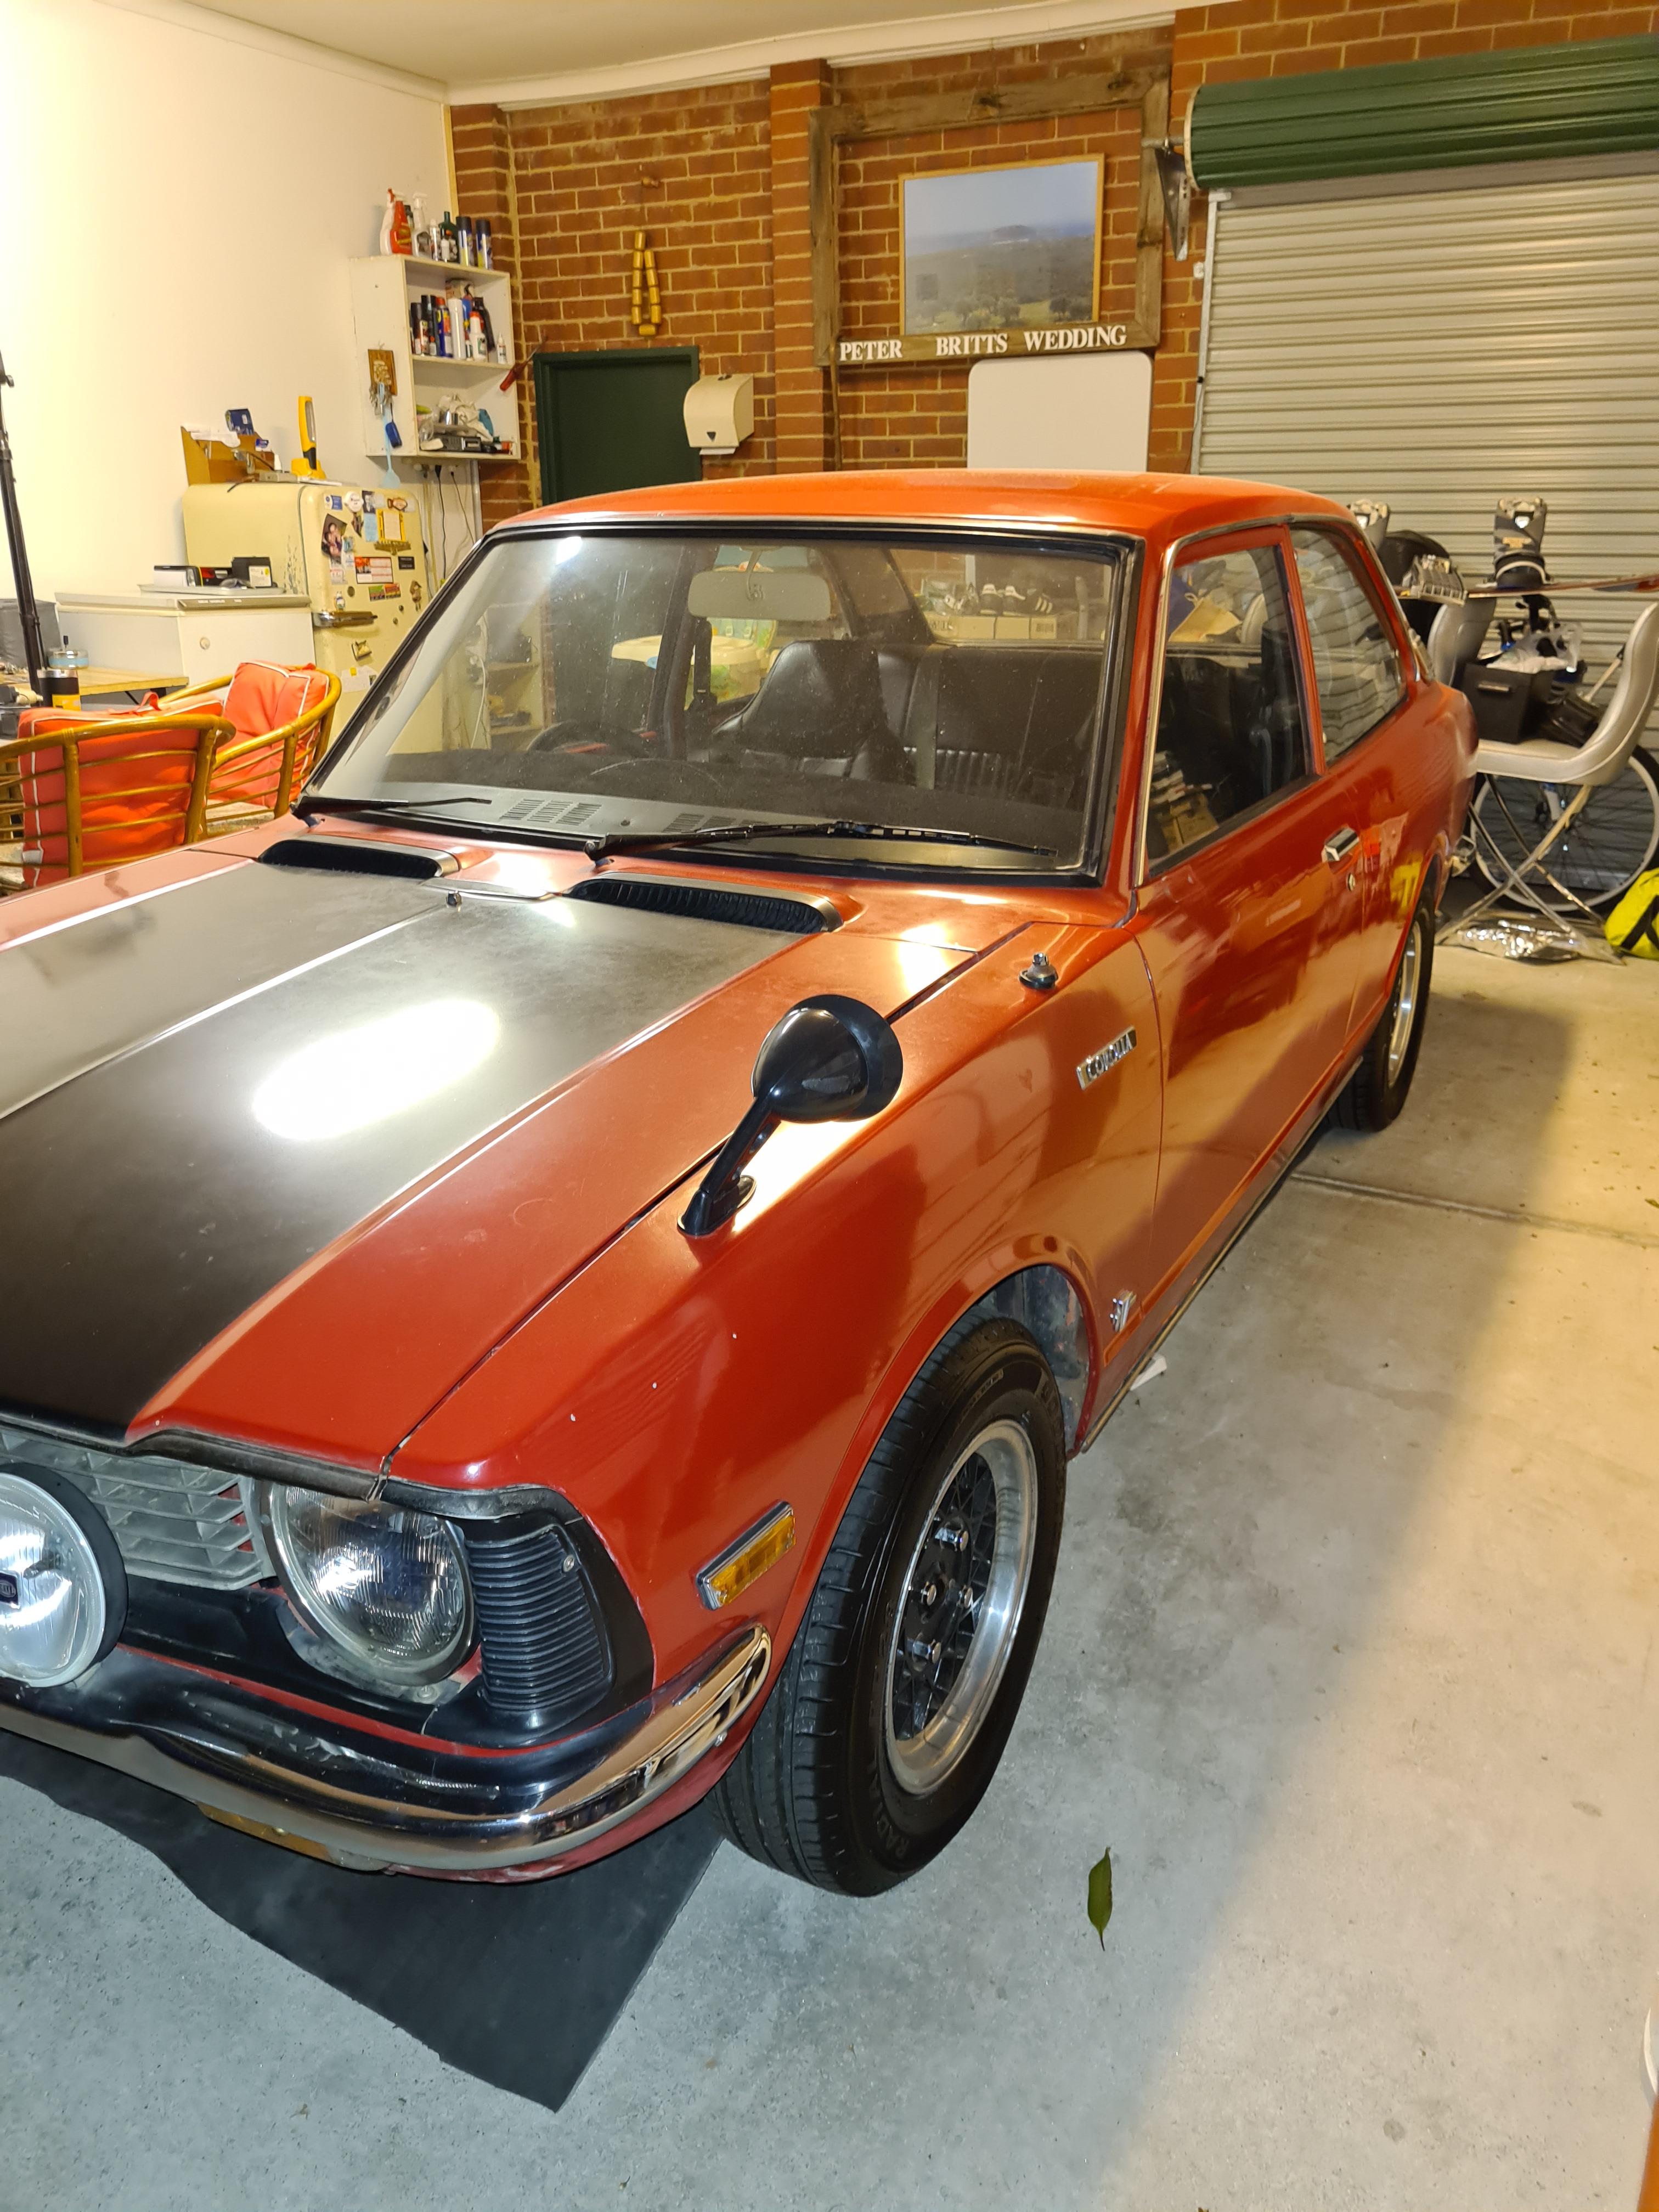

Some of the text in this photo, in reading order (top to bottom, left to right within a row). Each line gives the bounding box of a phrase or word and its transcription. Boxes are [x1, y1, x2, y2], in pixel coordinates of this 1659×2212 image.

[839, 325, 1127, 361] PETER BRITTS WEDDING
